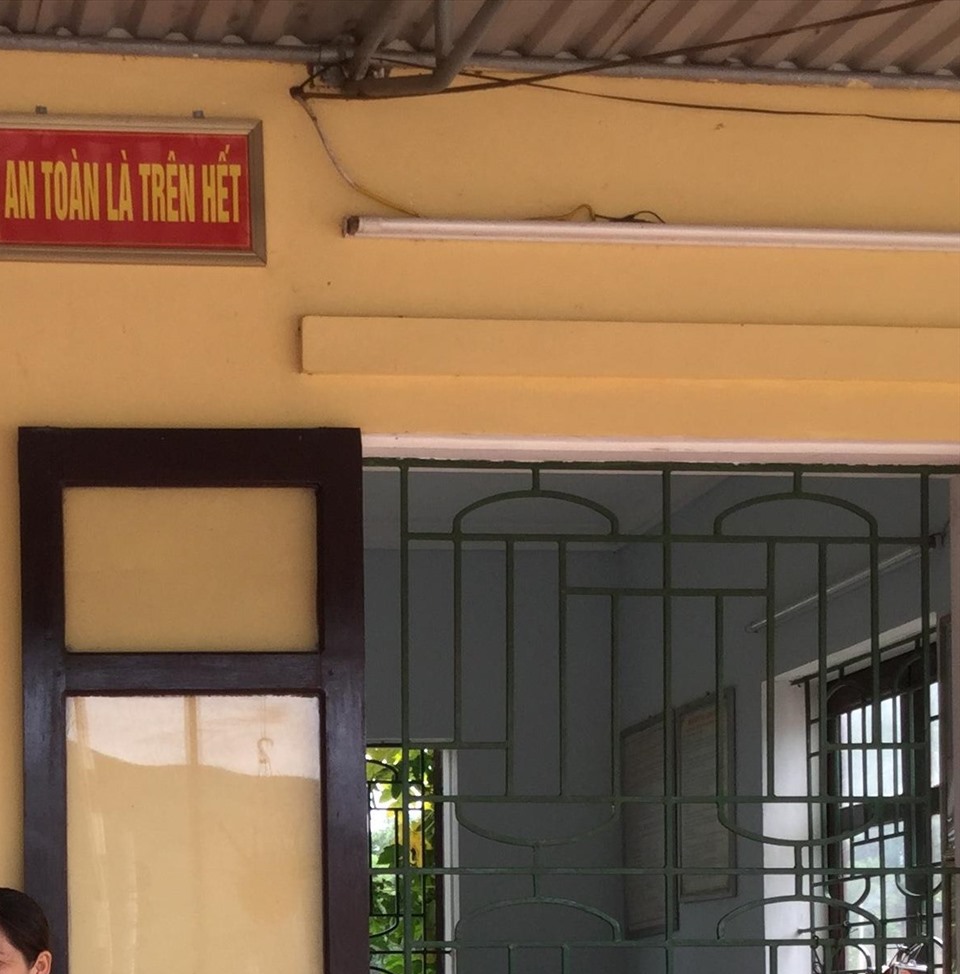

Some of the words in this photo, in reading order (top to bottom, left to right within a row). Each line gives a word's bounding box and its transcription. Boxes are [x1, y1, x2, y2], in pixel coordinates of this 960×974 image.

[4, 160, 35, 219] AN
[41, 148, 100, 221] TOÀN
[106, 150, 134, 222] LÀ
[139, 151, 195, 222] TRÊN
[202, 145, 242, 223] HẾT
